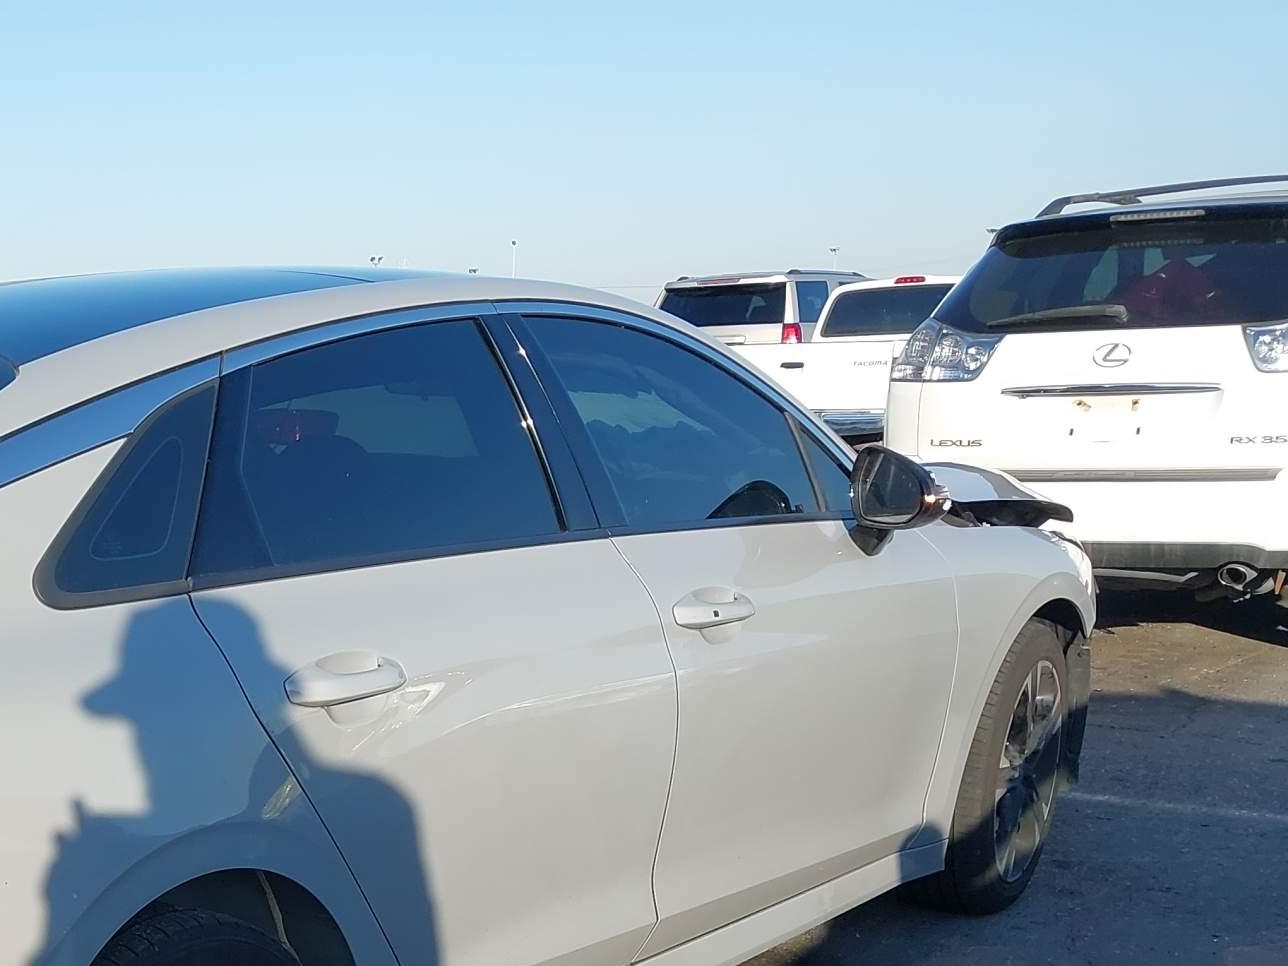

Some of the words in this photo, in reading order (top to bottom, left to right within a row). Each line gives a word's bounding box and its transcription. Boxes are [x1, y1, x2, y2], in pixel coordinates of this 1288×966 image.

[852, 359, 889, 367] TACOMA
[929, 439, 983, 448] LEXUS
[1229, 436, 1257, 445] RX
